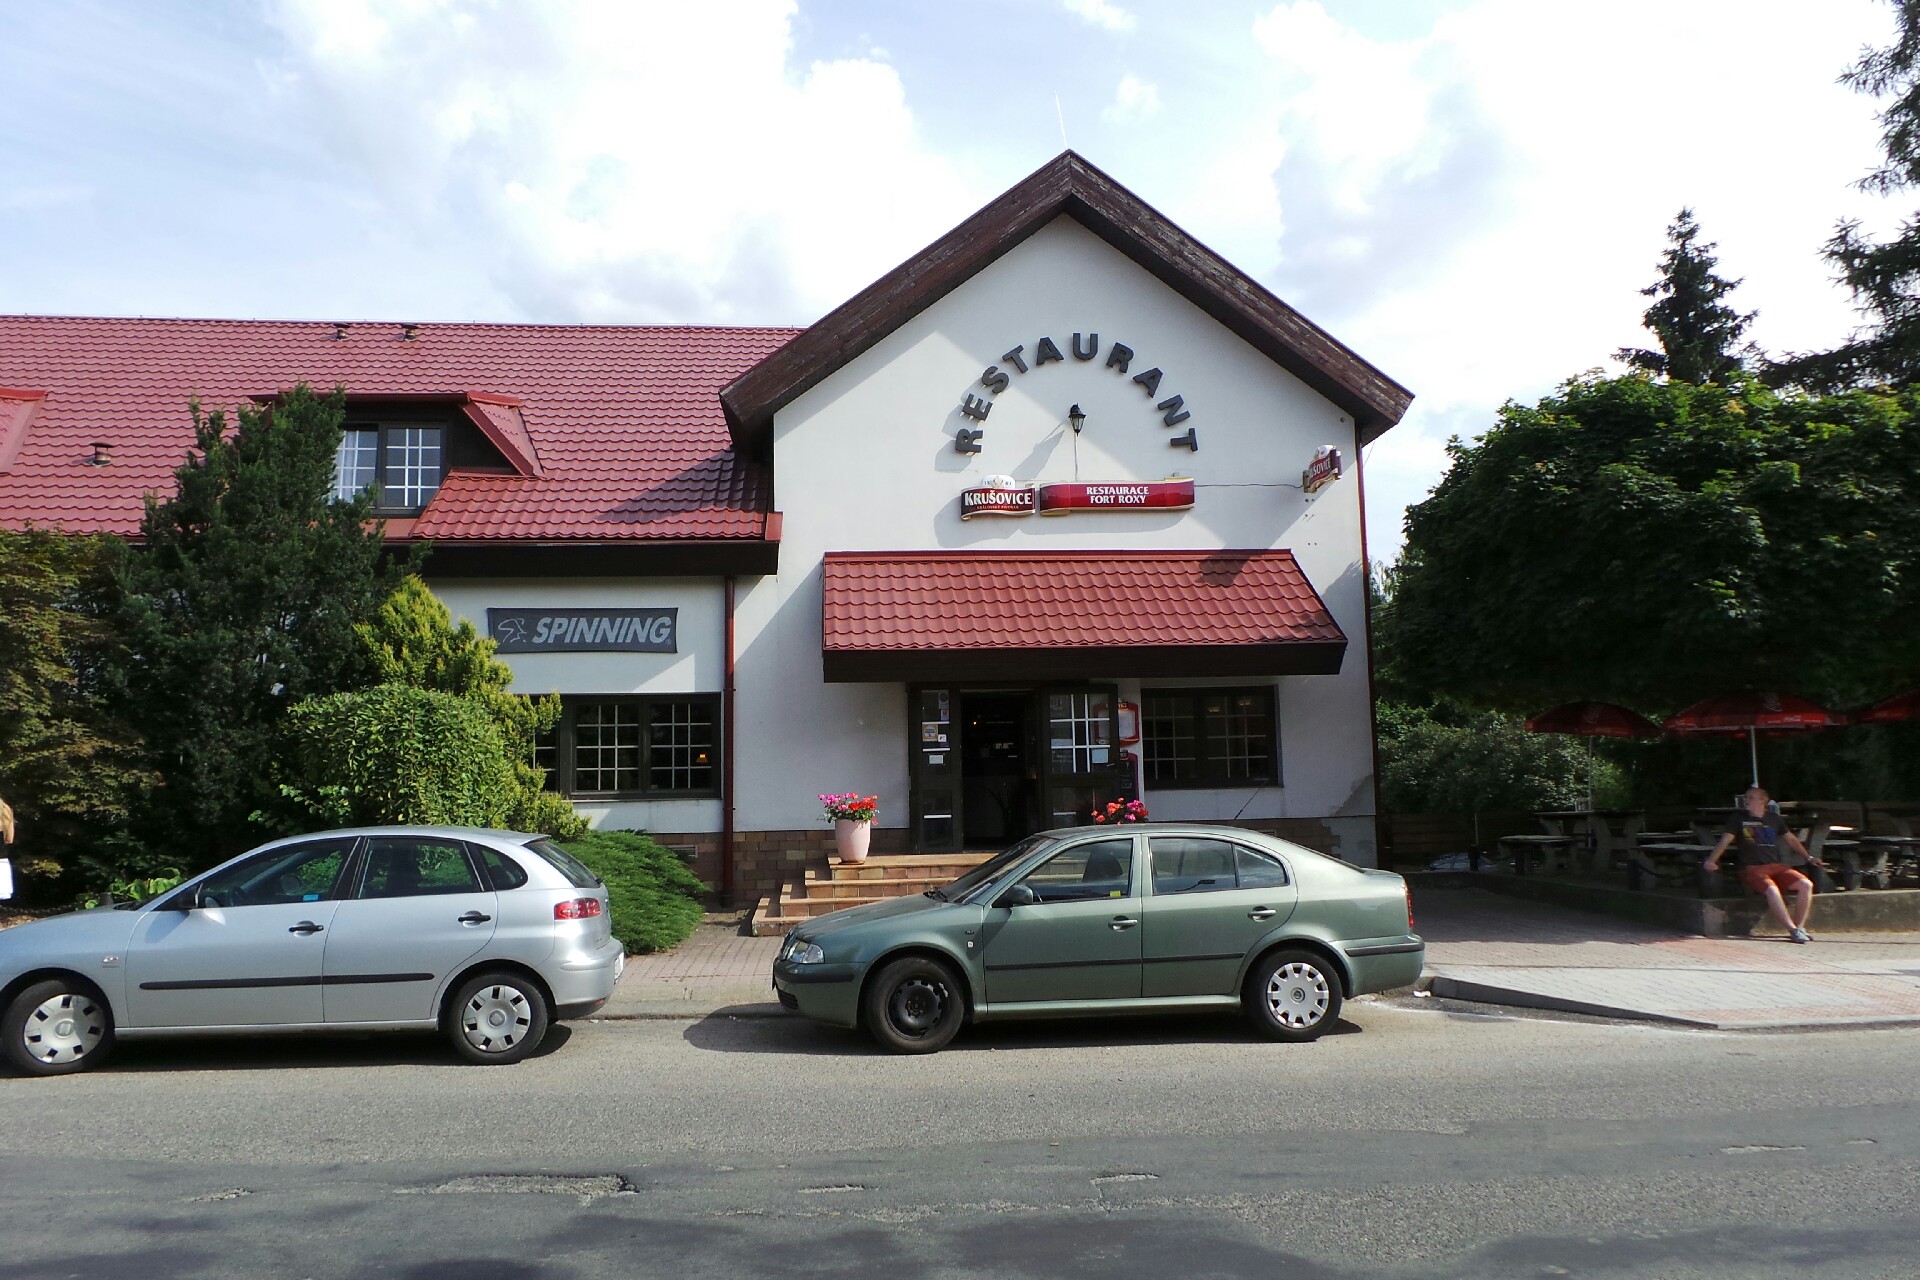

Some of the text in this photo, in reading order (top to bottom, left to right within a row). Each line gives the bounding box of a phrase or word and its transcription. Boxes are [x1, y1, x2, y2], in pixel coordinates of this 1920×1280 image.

[955, 332, 1198, 453] RESTAURANT
[964, 490, 1032, 506] KRUŠOVICE
[1086, 486, 1149, 495] RESTAURACE
[1090, 495, 1146, 504] FORT ROXY
[532, 616, 672, 644] SPINNING
